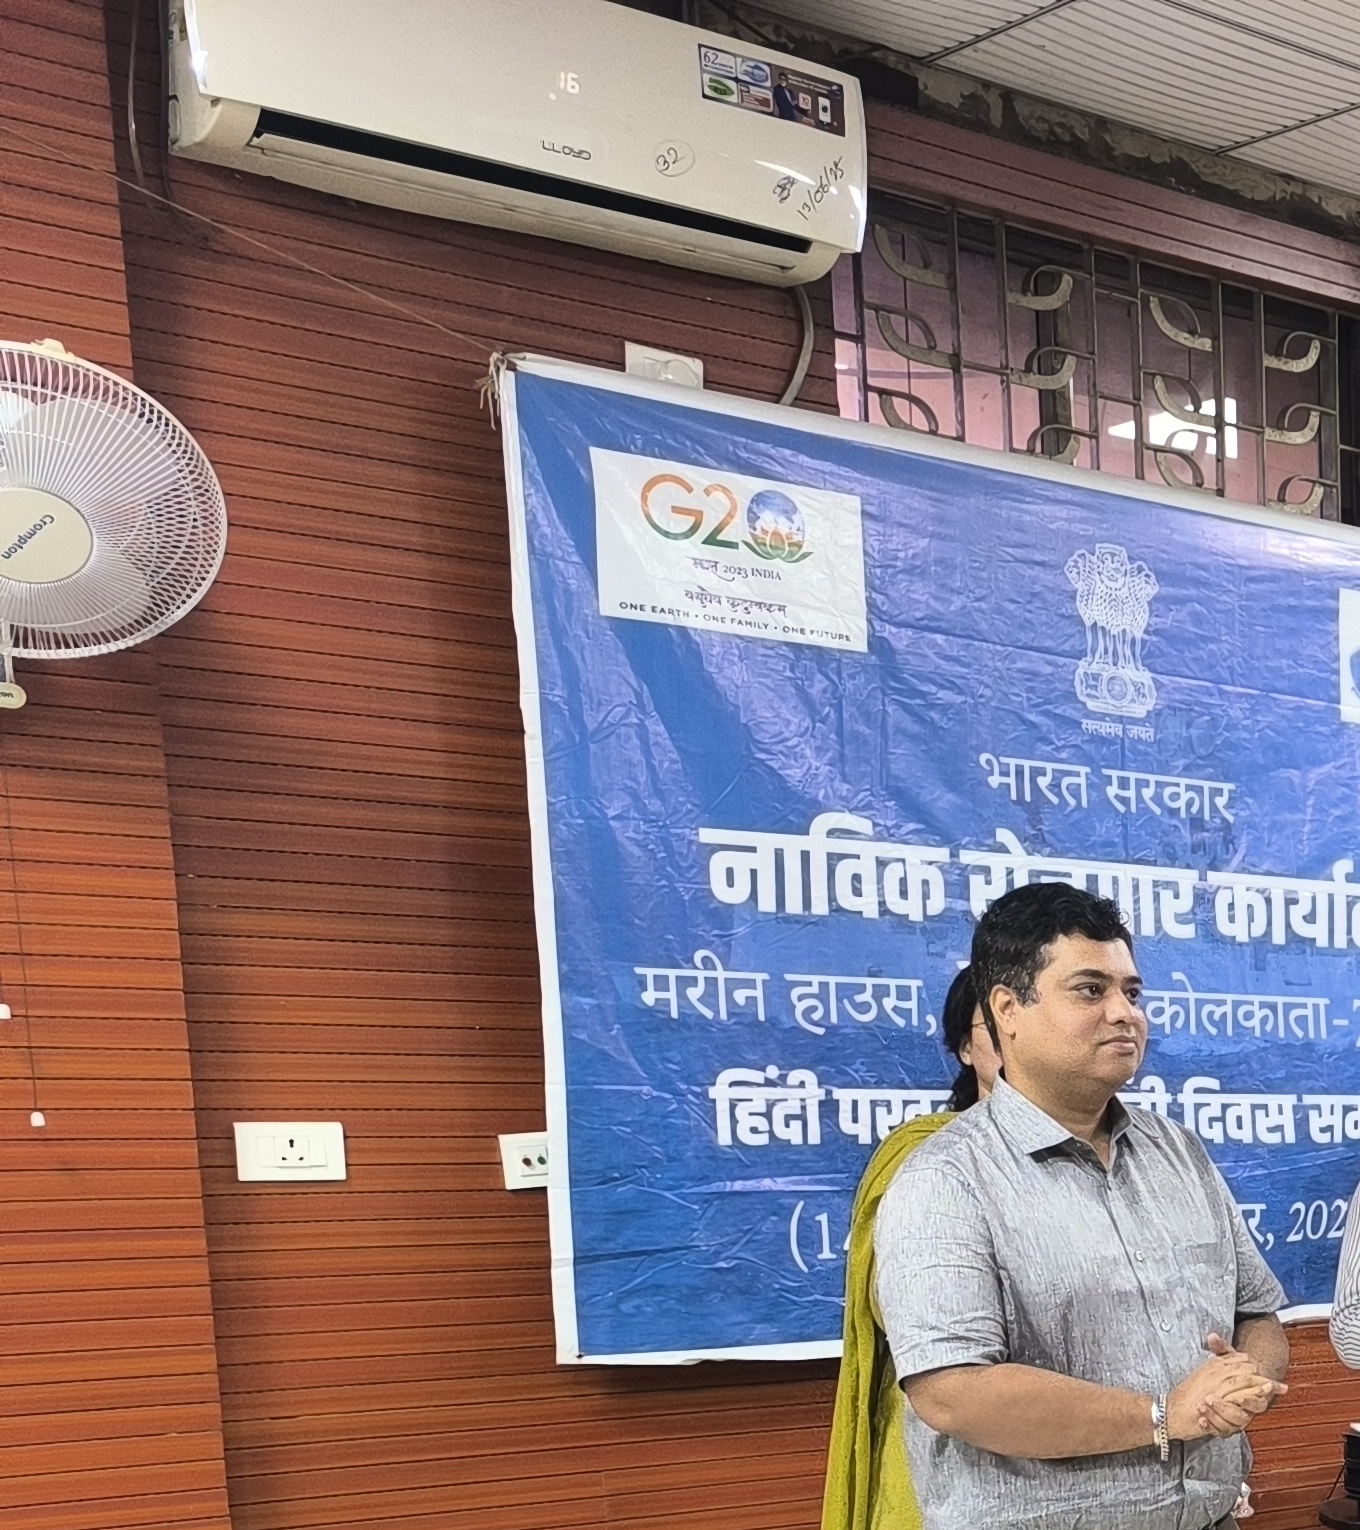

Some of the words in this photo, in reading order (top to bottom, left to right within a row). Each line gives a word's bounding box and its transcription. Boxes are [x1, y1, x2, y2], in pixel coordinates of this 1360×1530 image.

[559, 72, 580, 94] 16
[541, 140, 591, 160] LLOYD
[1, 514, 54, 559] Crompton
[722, 565, 749, 579] 2023
[751, 567, 782, 581] INDIA
[619, 601, 646, 612] ONE
[651, 605, 690, 618] EARTH
[703, 613, 726, 624] ONE
[730, 617, 769, 630] FAMILY
[782, 625, 806, 636] ONE
[810, 629, 851, 642] FUTURE
[979, 752, 1092, 808] भारत
[1101, 767, 1236, 824] सरकार
[699, 812, 950, 921] नाविक
[633, 949, 770, 1022] मरीन
[784, 974, 938, 1036] हाउस,
[708, 1064, 826, 1146] हिंदी
[1177, 1076, 1298, 1145] दिवस
